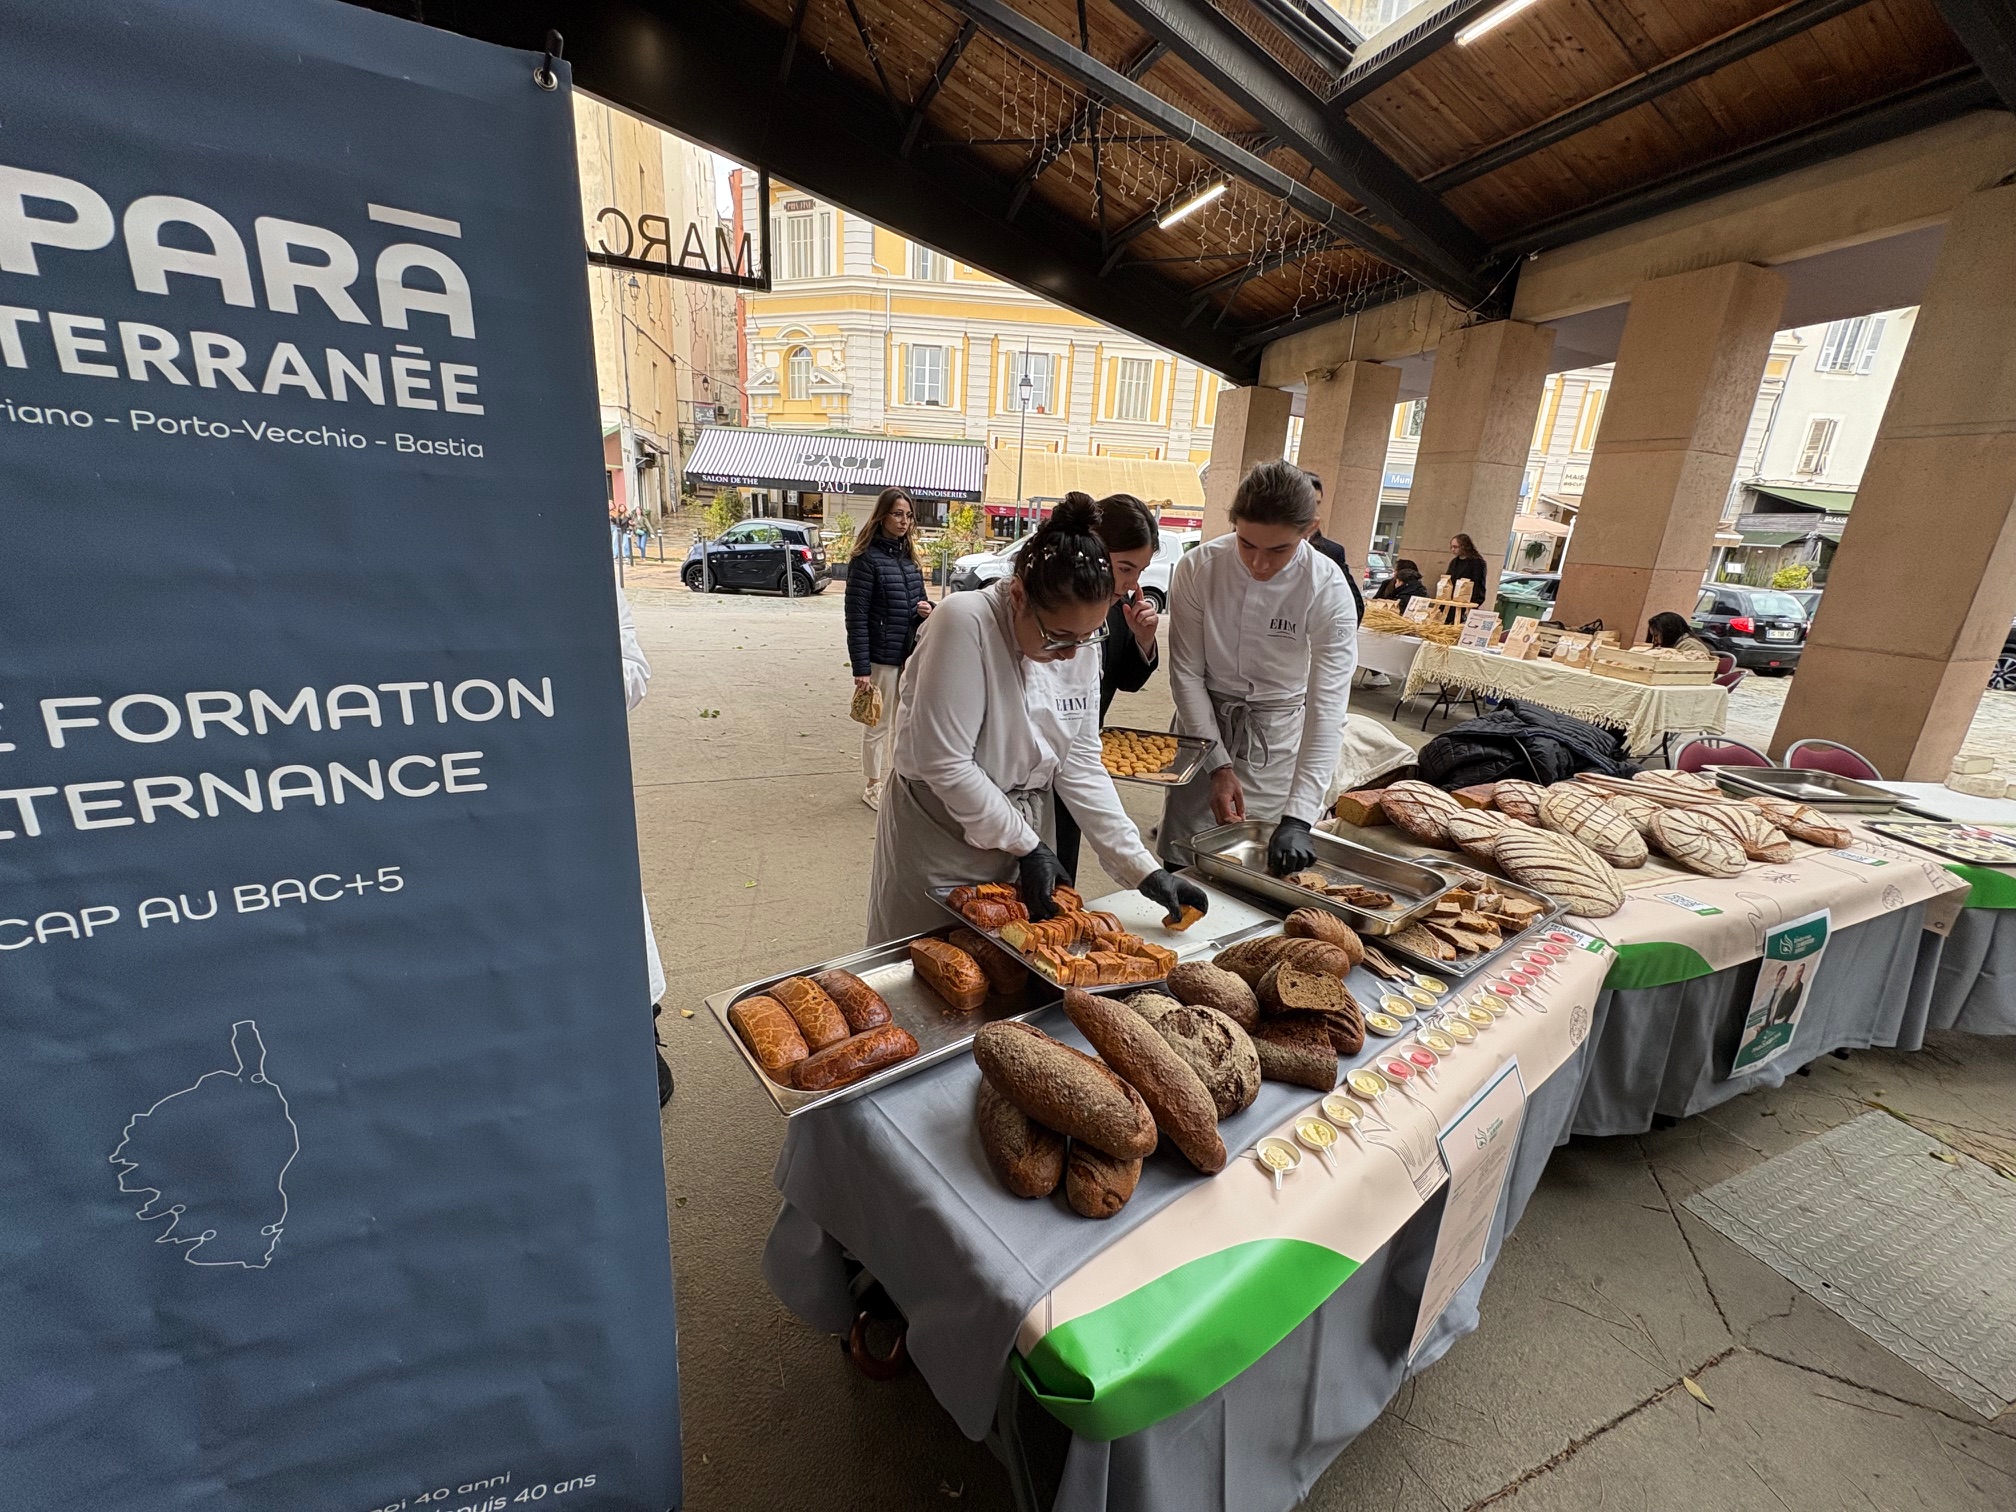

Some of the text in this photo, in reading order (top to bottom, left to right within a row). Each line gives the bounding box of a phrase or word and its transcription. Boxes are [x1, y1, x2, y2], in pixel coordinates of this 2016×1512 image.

[130, 408, 367, 449] Porto-Vecchio
[395, 433, 484, 459] Bastia
[796, 453, 882, 471] PAUL
[702, 475, 729, 483] SALON
[730, 476, 741, 484] DE
[818, 481, 855, 494] PAUL
[910, 489, 967, 499] VIENNOISERIES
[1270, 618, 1297, 634] EHM
[40, 677, 554, 749] FORMATION
[1055, 697, 1087, 711] EHM
[0, 866, 404, 950] CAP AU BAC+5
[414, 1488, 450, 1504] 40
[457, 1471, 510, 1494] anni
[513, 1484, 547, 1504] 40
[553, 1474, 597, 1495] ans
